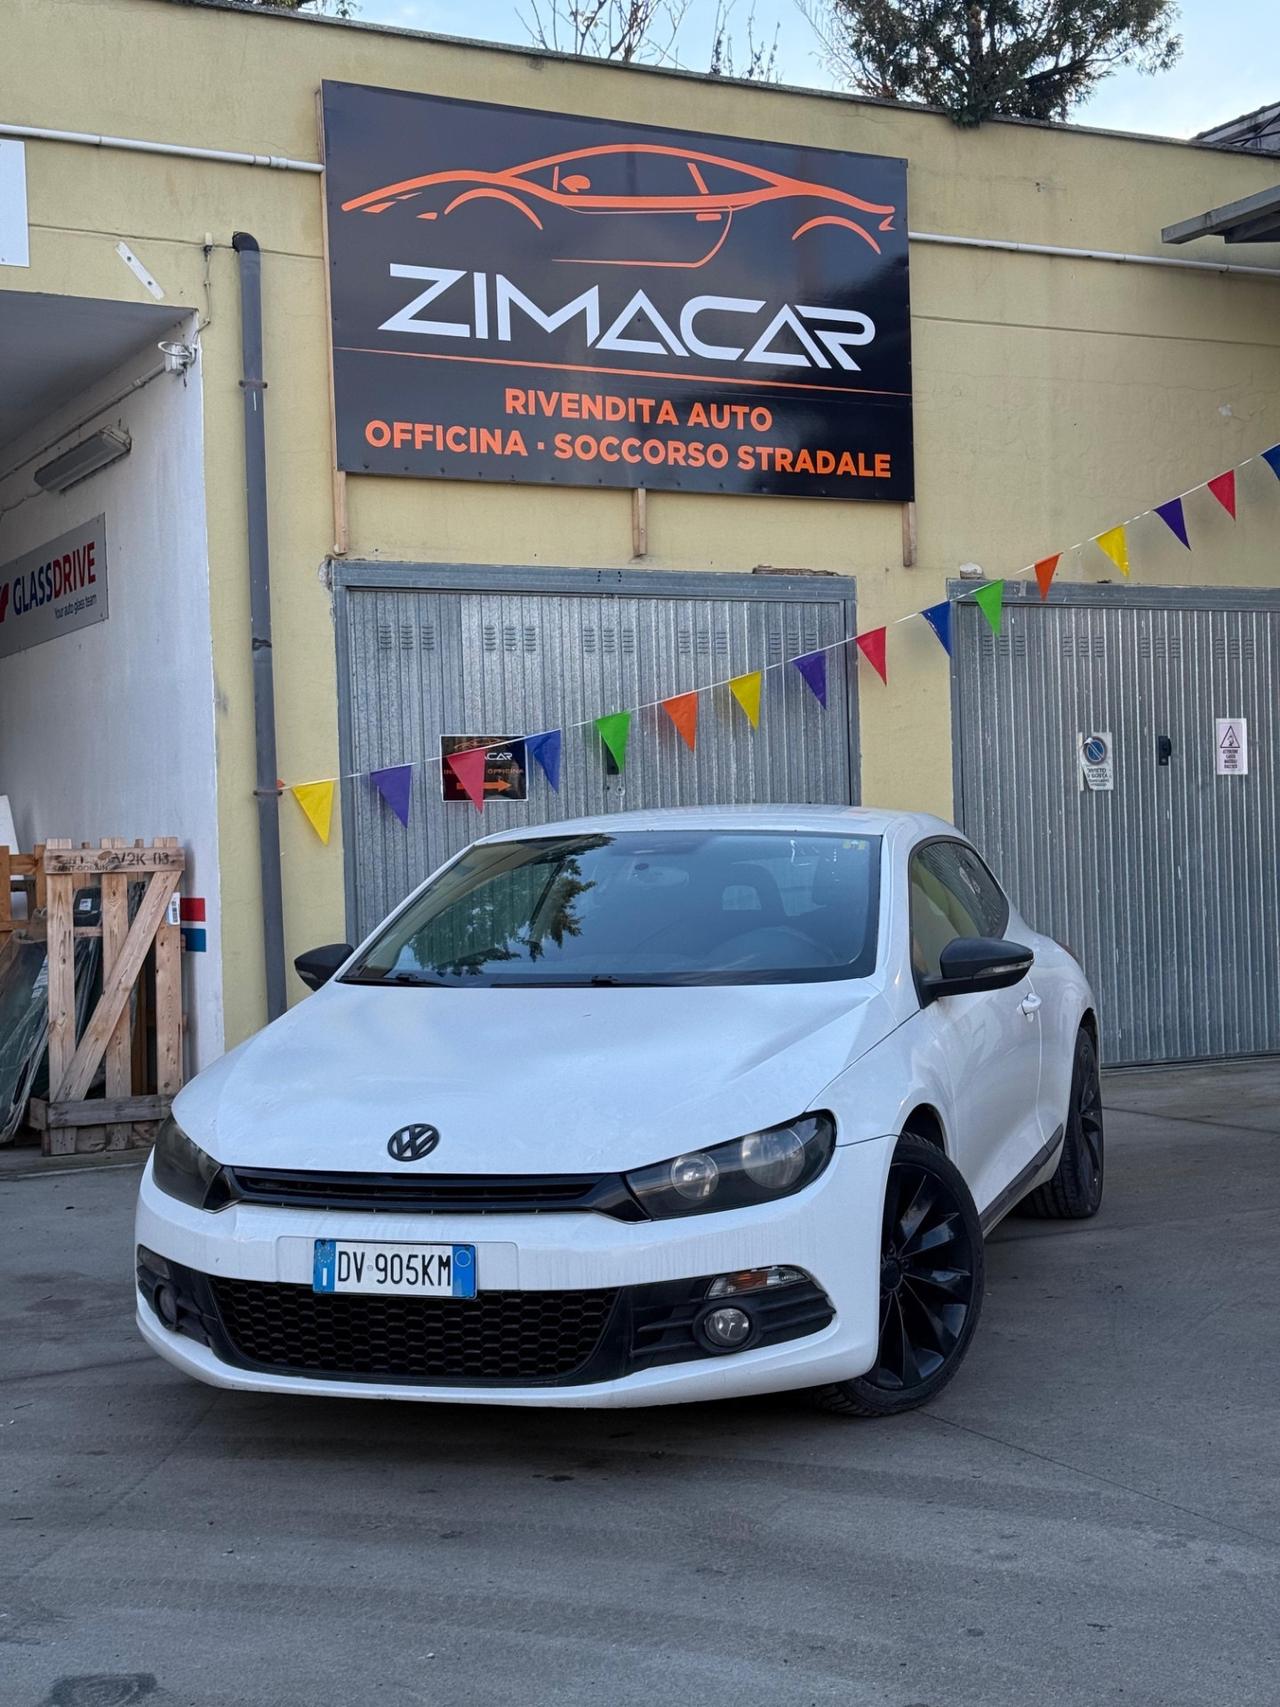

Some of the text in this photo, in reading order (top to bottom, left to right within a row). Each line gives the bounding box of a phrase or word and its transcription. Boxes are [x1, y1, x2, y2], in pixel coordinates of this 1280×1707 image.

[377, 263, 876, 371] ZIMACAR
[505, 388, 773, 432] RIVENDITA AUTO
[365, 420, 892, 478] OFFICINA SOCCORSO STRADALE
[13, 541, 96, 616] GLASSDRIVE
[337, 1251, 365, 1283] DV
[375, 1253, 451, 1287] 905KM
